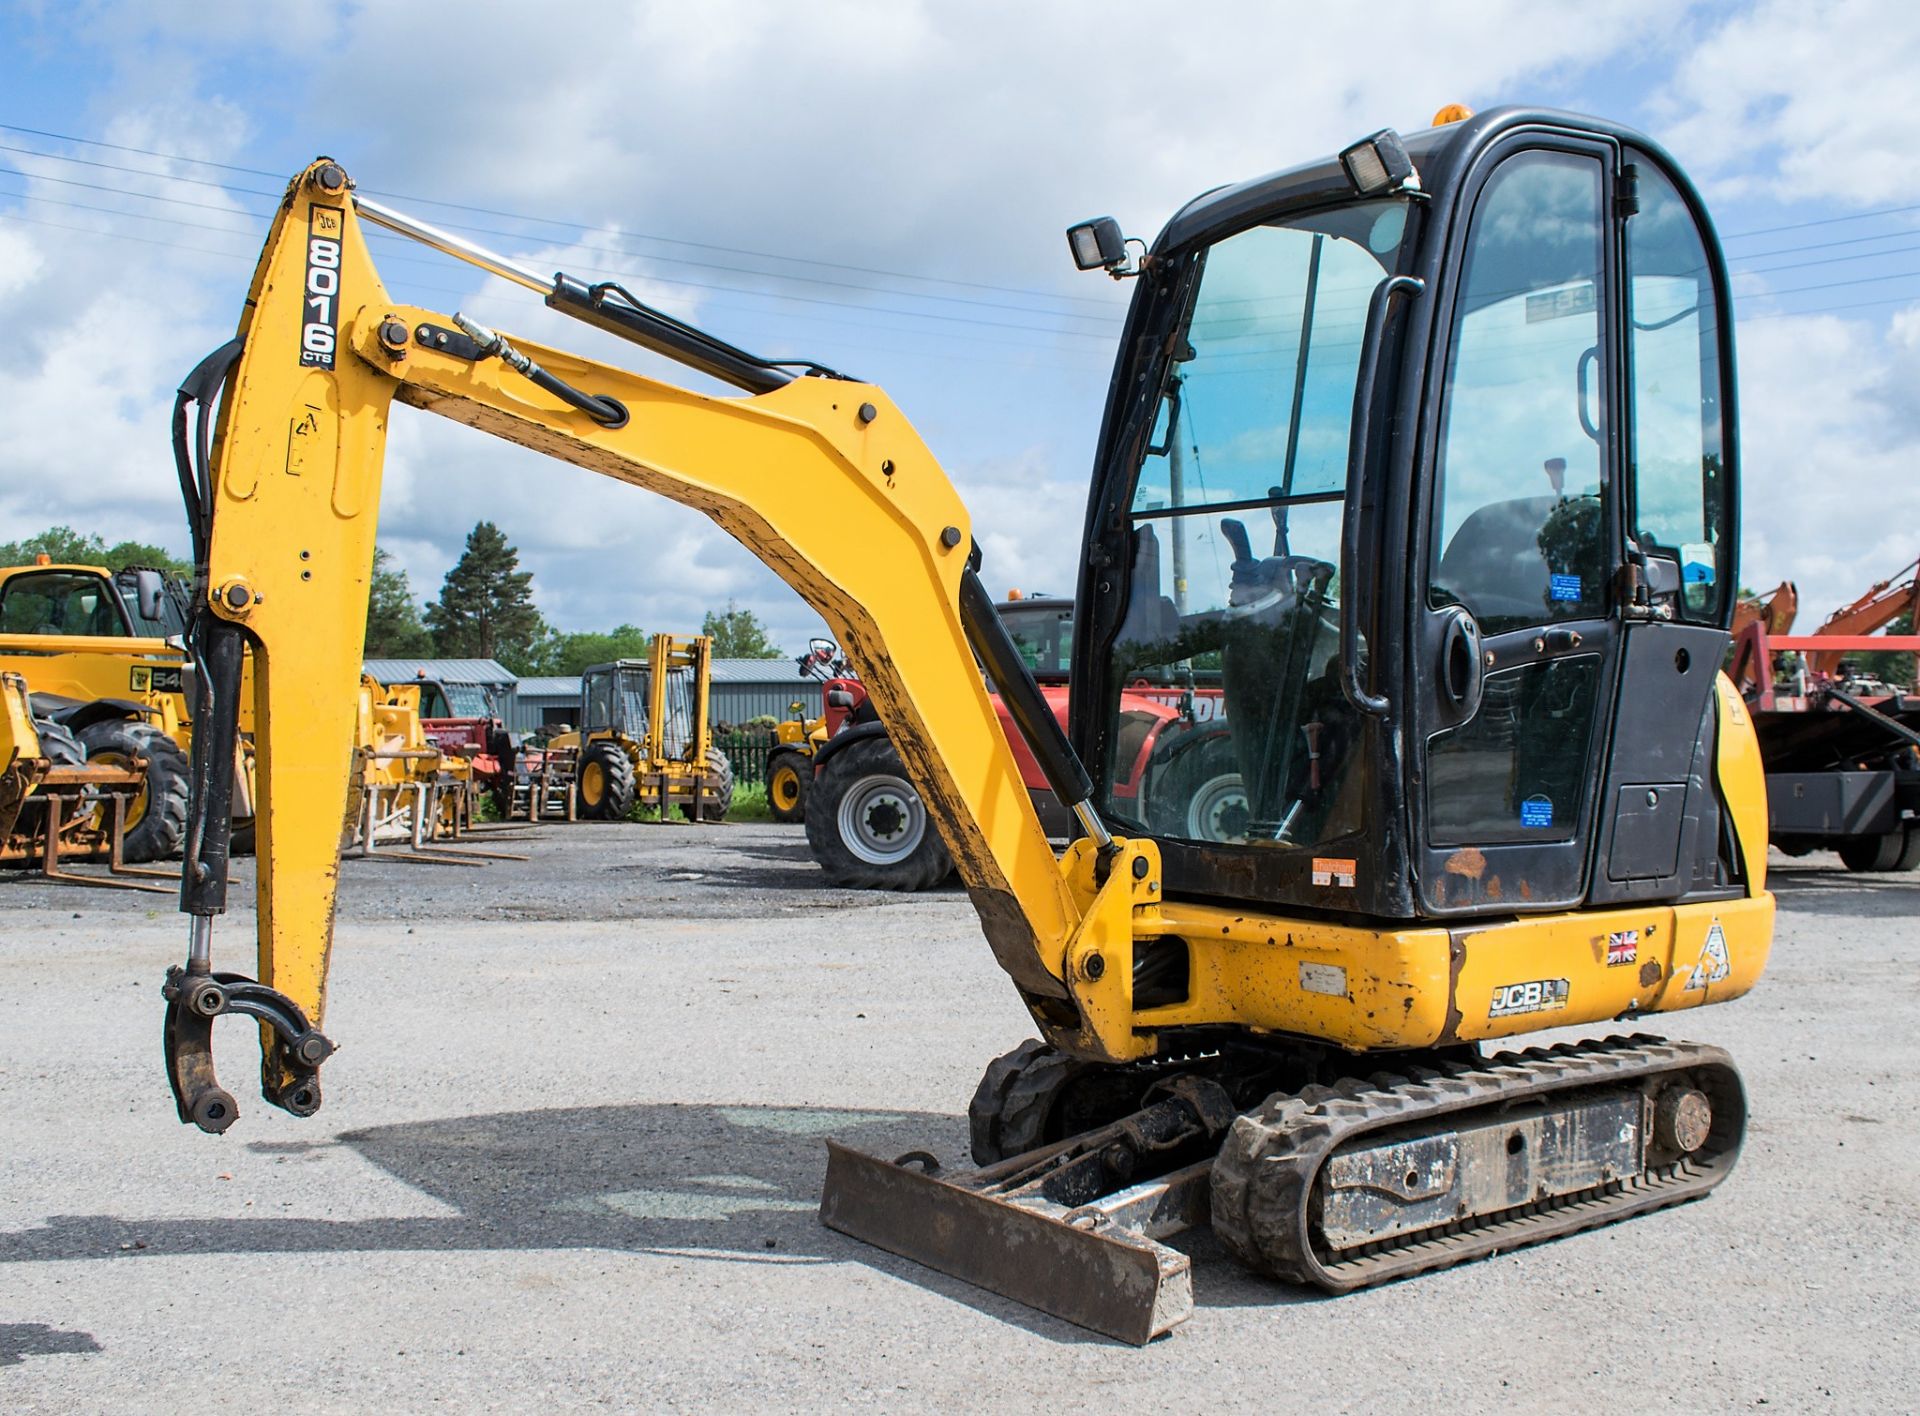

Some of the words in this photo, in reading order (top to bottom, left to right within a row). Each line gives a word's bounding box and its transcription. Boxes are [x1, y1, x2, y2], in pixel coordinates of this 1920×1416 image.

[320, 214, 337, 229] JCB
[303, 239, 340, 353] 8016
[303, 352, 333, 363] CTS
[153, 672, 183, 687] 54
[1492, 982, 1542, 1010] JCB
